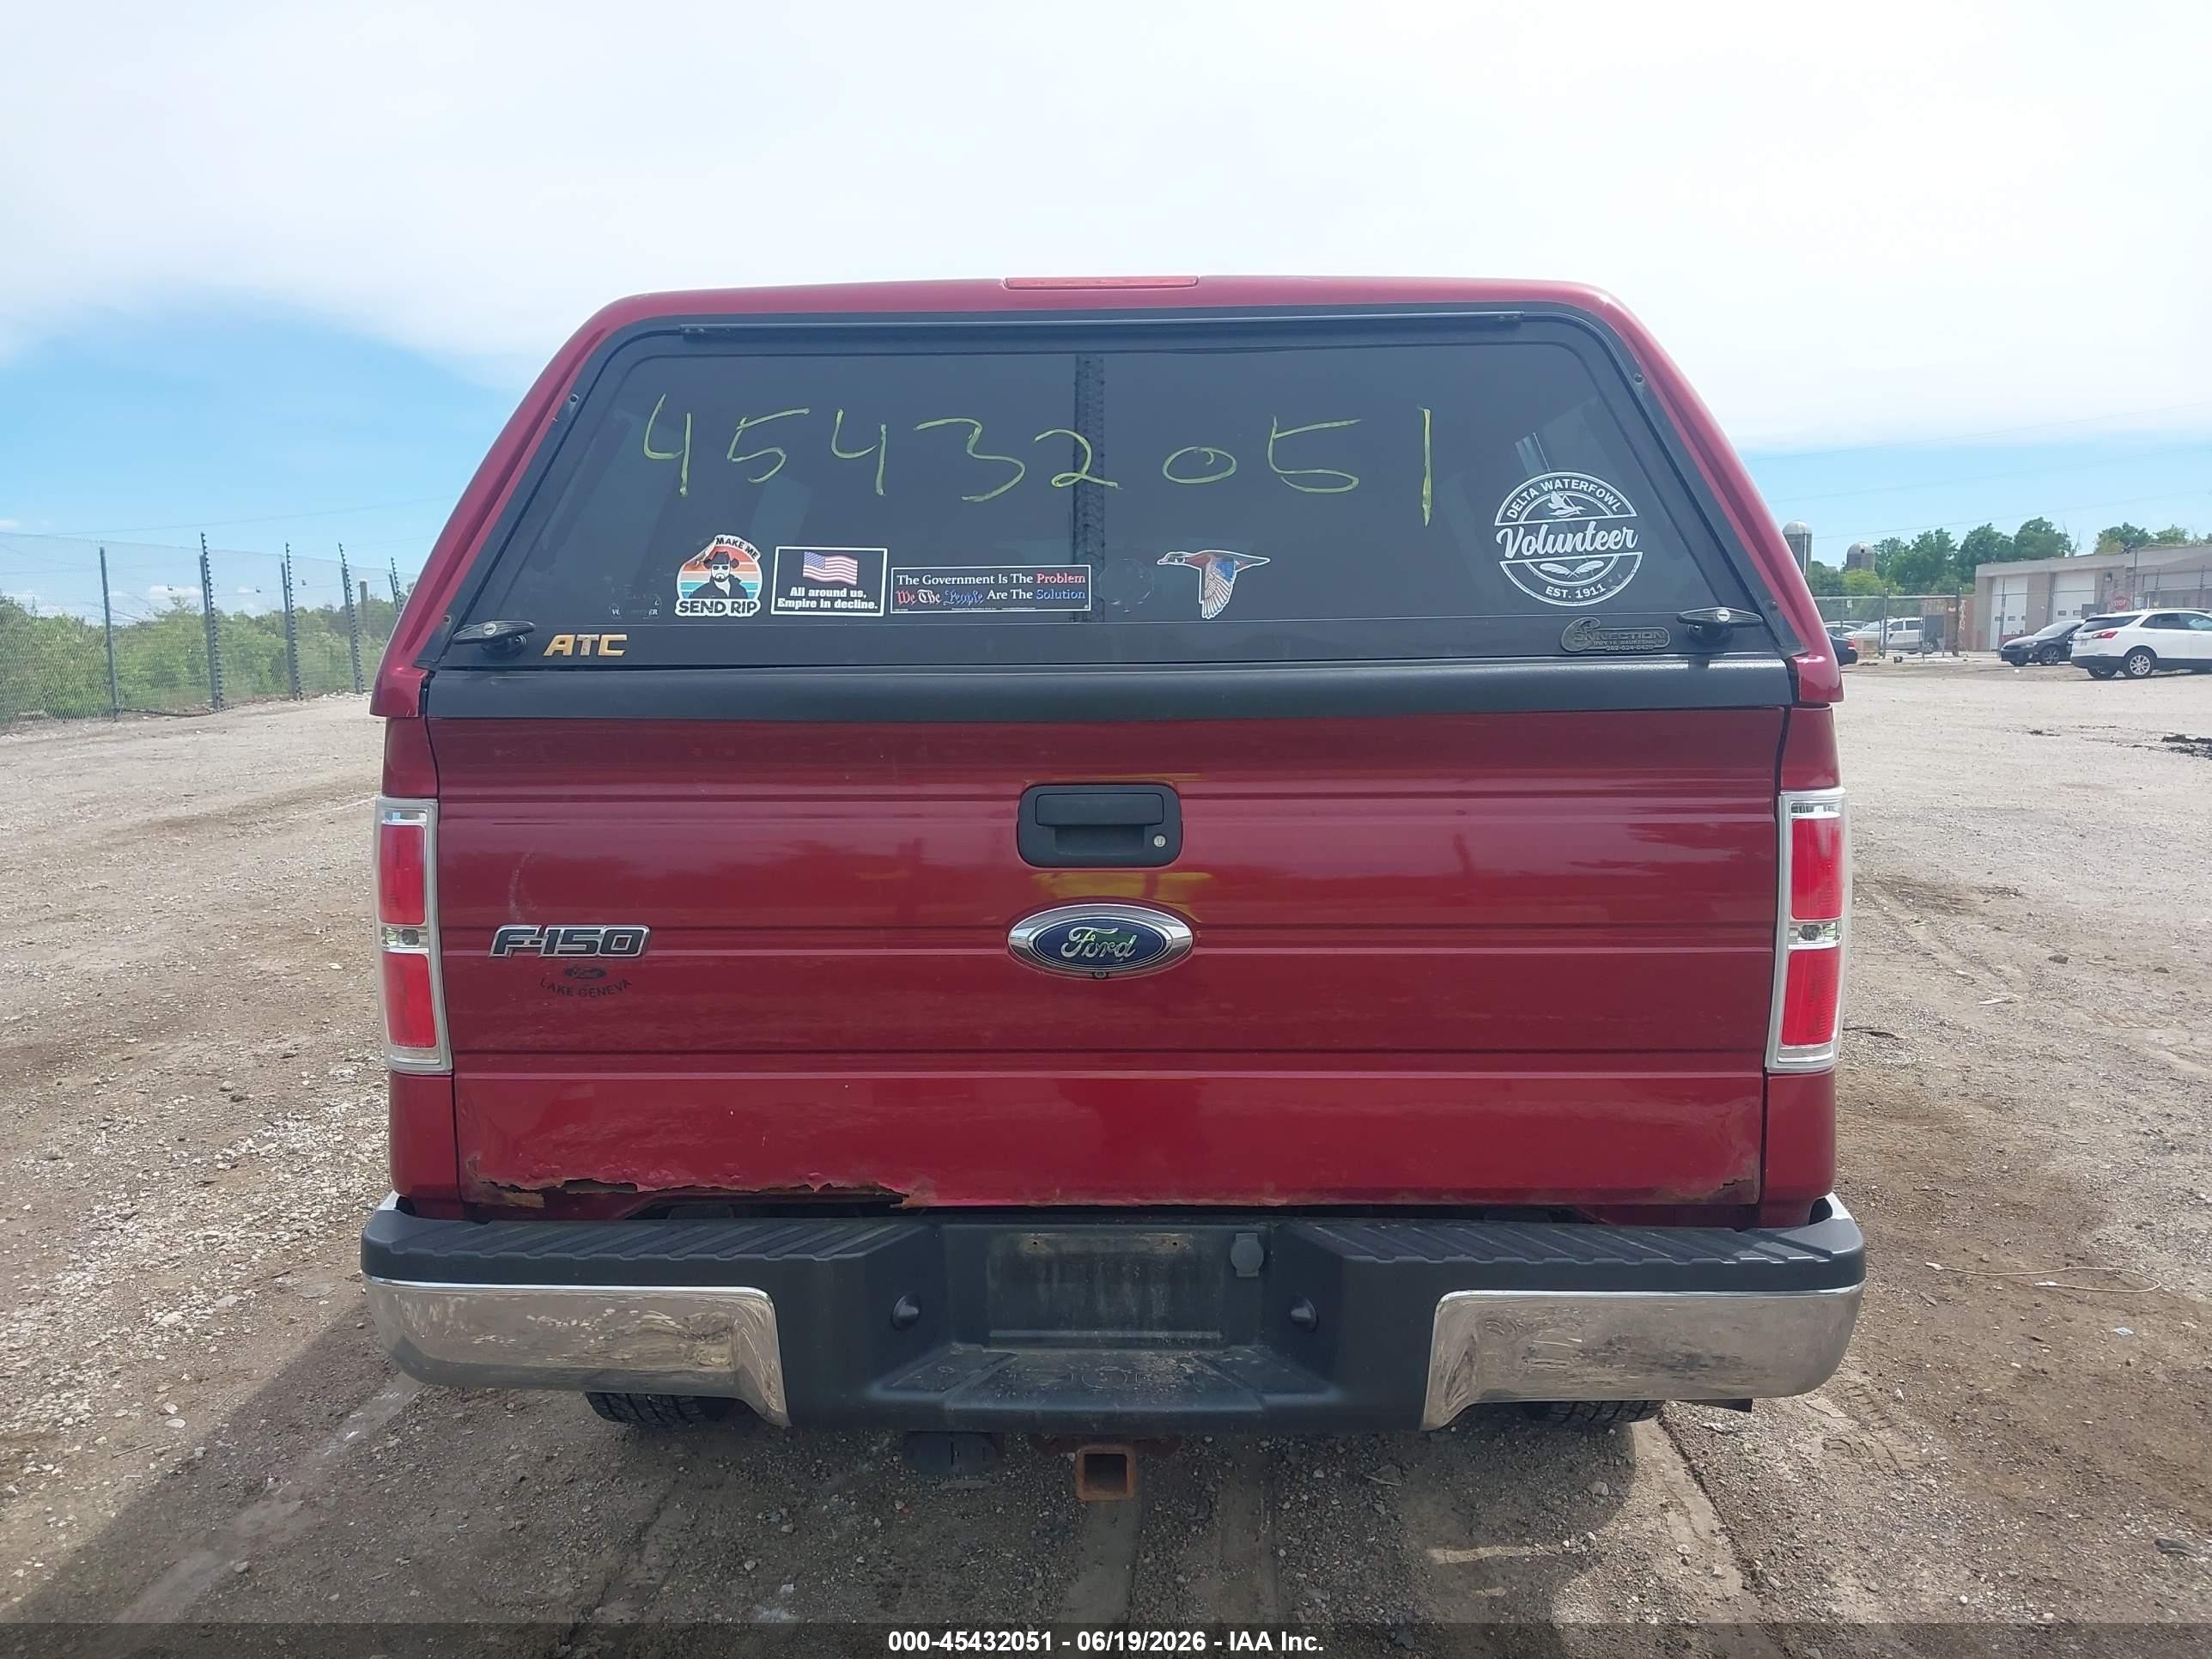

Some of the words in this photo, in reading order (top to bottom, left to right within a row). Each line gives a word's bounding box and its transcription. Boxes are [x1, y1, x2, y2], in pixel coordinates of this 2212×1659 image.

[643, 393, 1432, 527] 45432051
[1506, 488, 1540, 519] DELTA
[1540, 478, 1621, 512] WATERFOWL
[715, 537, 744, 550] MAKE
[744, 544, 759, 559] ME
[1496, 521, 1638, 559] Volunteer
[896, 574, 920, 586] The
[922, 574, 995, 586] Government
[998, 574, 1008, 584] Is
[1010, 573, 1033, 584] The
[1036, 573, 1086, 584] Problem
[790, 586, 805, 598] All
[808, 587, 848, 598] around
[849, 589, 867, 599] us,
[896, 590, 917, 605] We
[917, 589, 942, 604] The
[986, 589, 1008, 599] Are
[1010, 588, 1033, 599] The
[1036, 589, 1086, 599] Solution
[1545, 586, 1571, 599] EST.
[1576, 583, 1607, 599] 1911
[678, 600, 726, 614] SEND
[730, 600, 758, 614] RIP
[777, 598, 817, 611] Empire
[820, 599, 831, 609] in
[834, 599, 878, 610] decline.
[543, 634, 628, 657] ATC
[488, 924, 651, 958] F-150
[1060, 927, 1138, 961] Ford
[540, 978, 574, 997] LAKE
[577, 978, 632, 998] GENEVA
